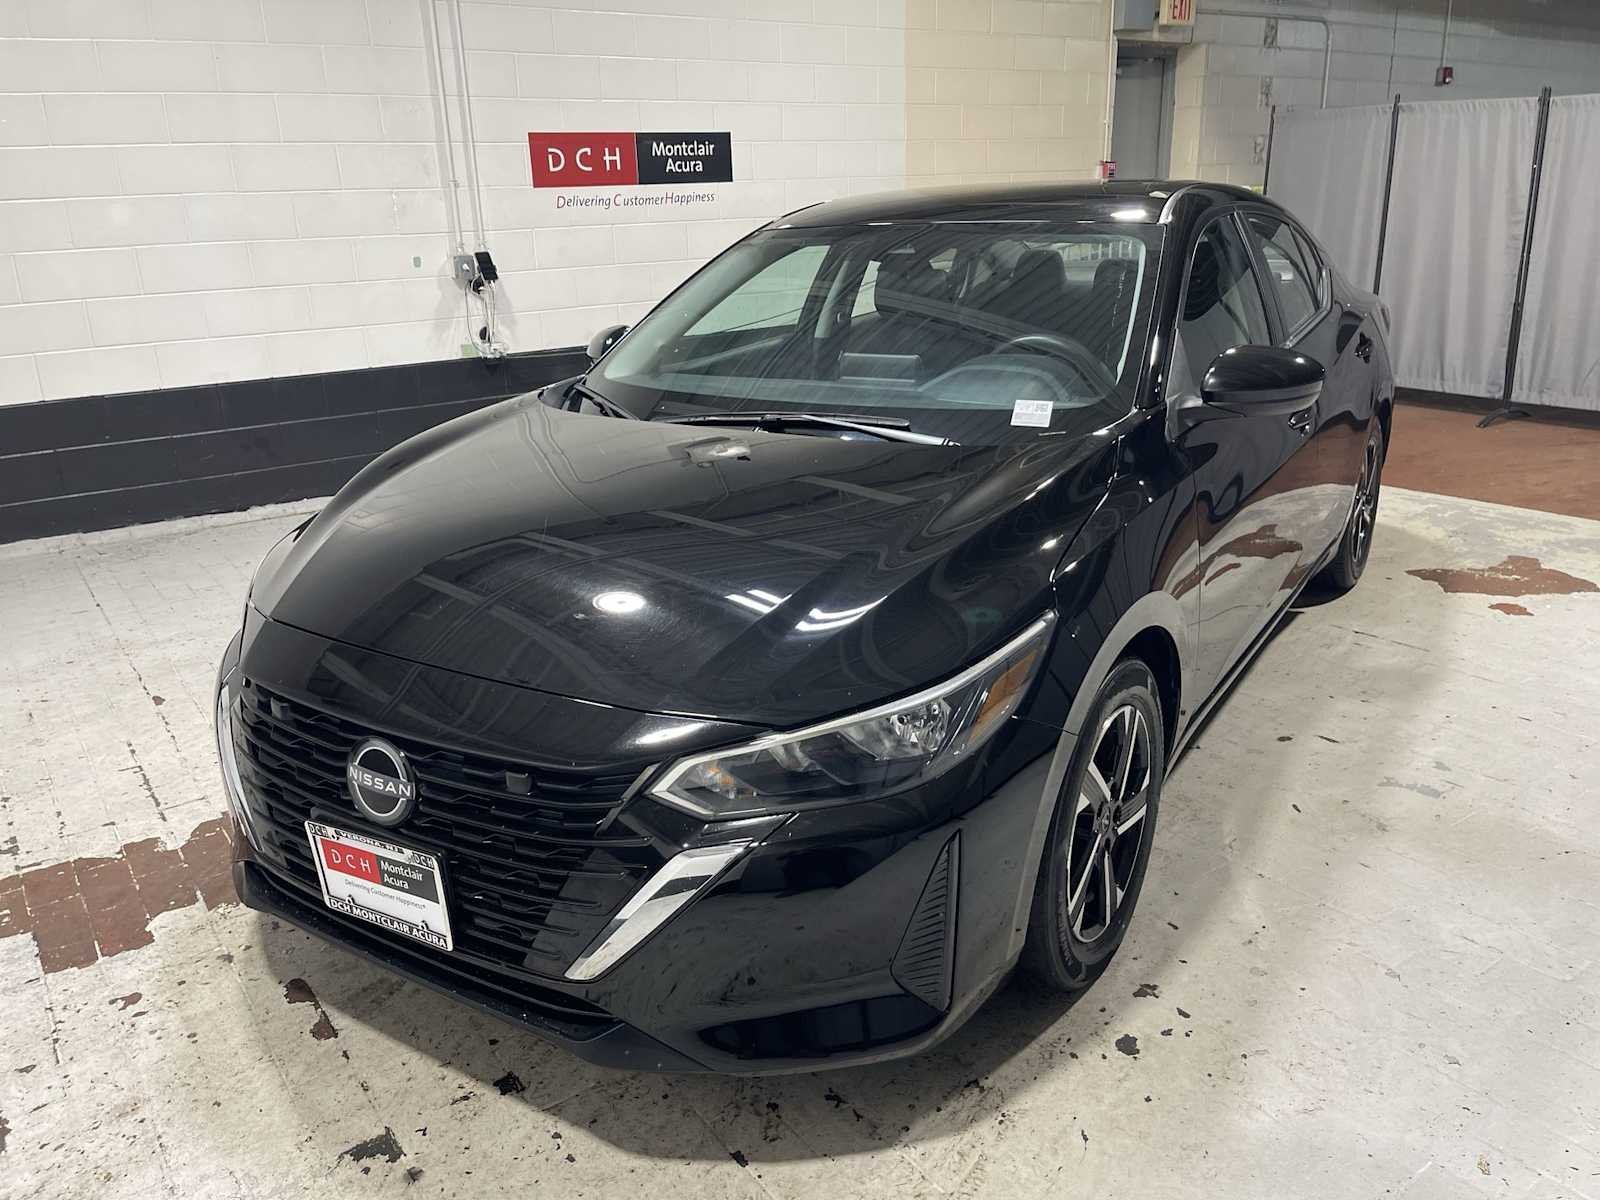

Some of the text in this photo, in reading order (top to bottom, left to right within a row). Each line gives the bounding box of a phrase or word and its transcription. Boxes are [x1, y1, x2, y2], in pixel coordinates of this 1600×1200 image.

[1172, 0, 1190, 20] EXIT
[652, 141, 714, 157] Montclair
[666, 158, 703, 173] Acura
[556, 191, 715, 209] Delivering Customer Happiness
[349, 766, 411, 796] NISSAN
[309, 823, 327, 836] DCH
[414, 853, 434, 868] DCH
[380, 860, 423, 881] Montclair
[383, 874, 409, 889] Acura
[331, 899, 447, 948] DCH MONTCLAIR ACURA
